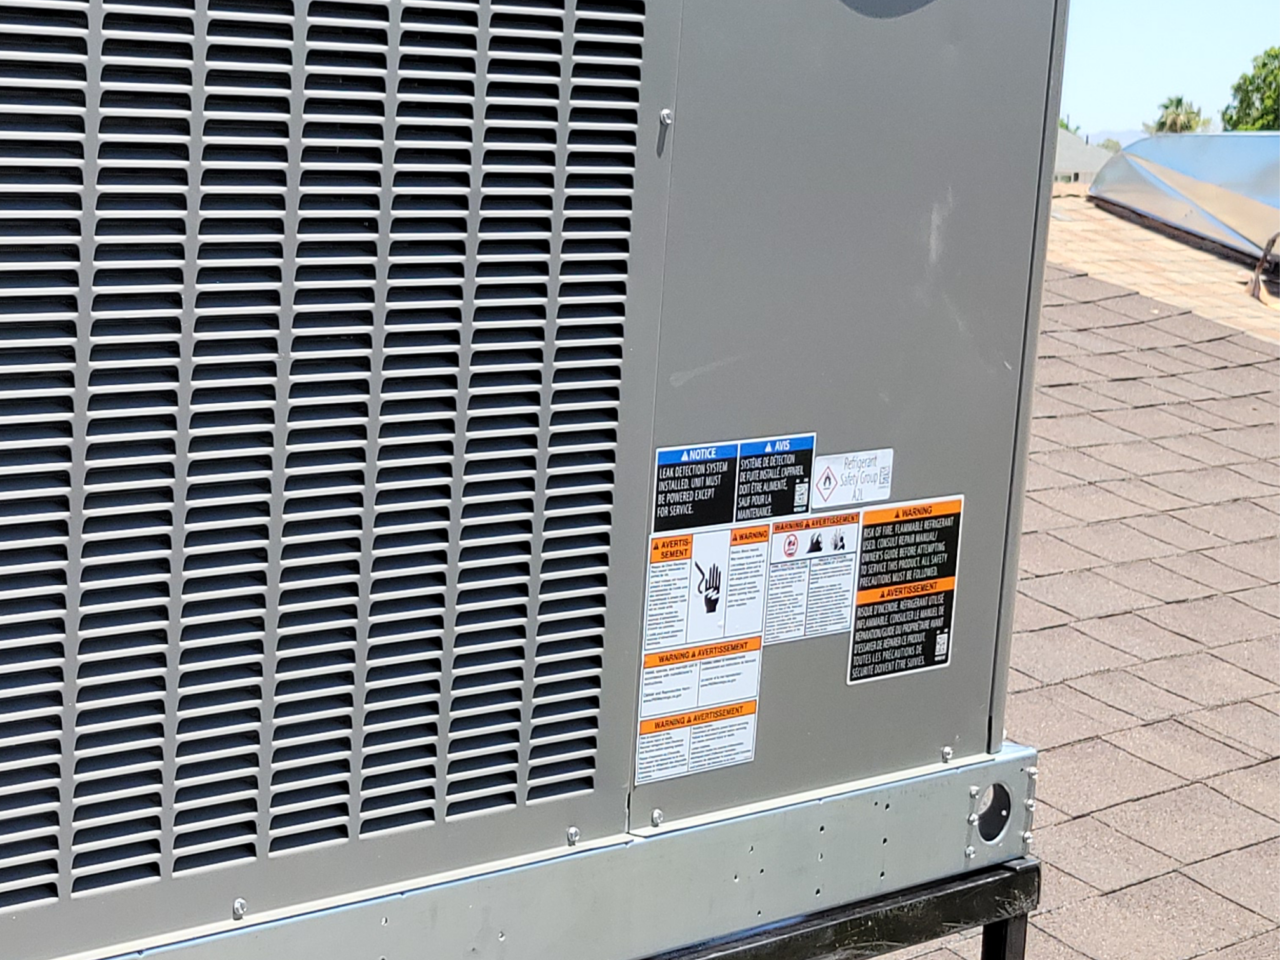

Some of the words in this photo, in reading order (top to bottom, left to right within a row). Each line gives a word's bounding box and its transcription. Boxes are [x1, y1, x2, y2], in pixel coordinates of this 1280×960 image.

[775, 440, 790, 452] AVIS
[690, 448, 716, 460] NOTICE
[763, 457, 769, 467] DE
[770, 453, 795, 466] DÉTECTION
[659, 467, 674, 479] LEAK
[675, 464, 706, 478] DETECTION
[706, 462, 728, 474] SYSTEM
[844, 456, 877, 472] Refrigerant
[659, 478, 690, 492] INSTALLED.
[691, 477, 705, 488] UNIT
[706, 475, 721, 487] MUST
[740, 472, 746, 482] DE
[840, 472, 860, 488] Safety
[860, 471, 878, 486] Group
[658, 494, 665, 505] BE
[667, 490, 694, 504] POWERED
[695, 488, 715, 501] EXCEPT
[739, 484, 750, 495] DOIT
[738, 497, 750, 508] SAUF
[751, 495, 765, 506] POUR
[766, 494, 772, 504] LA
[657, 506, 669, 518] FOR
[670, 503, 694, 516] SERVICE.
[902, 505, 933, 518] WARNING
[774, 521, 804, 531] WARNING
[864, 528, 874, 539] RISK
[875, 526, 882, 537] OF
[739, 530, 768, 540] WARNING
[661, 539, 691, 549] AVERTIS-
[877, 536, 898, 549] CONSULT
[661, 549, 688, 559] SEMENT
[884, 548, 899, 560] GUIDE
[899, 546, 917, 558] BEFORE
[861, 565, 867, 575] TO
[868, 562, 887, 575] SERVICE
[887, 561, 898, 571] THIS
[921, 556, 930, 566] ALL
[931, 553, 948, 565] SAFETY
[860, 573, 892, 588] PRECAUTIONS
[892, 571, 906, 583] MUST
[906, 570, 912, 580] BE
[886, 582, 938, 598] AVERTISSEMENT
[915, 610, 920, 620] LE
[939, 605, 945, 616] DE
[658, 651, 689, 663] WARNING
[697, 642, 748, 657] AVERTISSEMENT
[853, 654, 871, 666] TOUTES
[872, 652, 882, 663] LES
[916, 645, 923, 655] DE
[654, 717, 685, 729] WARNING
[692, 705, 743, 721] AVERTISSEMENT
